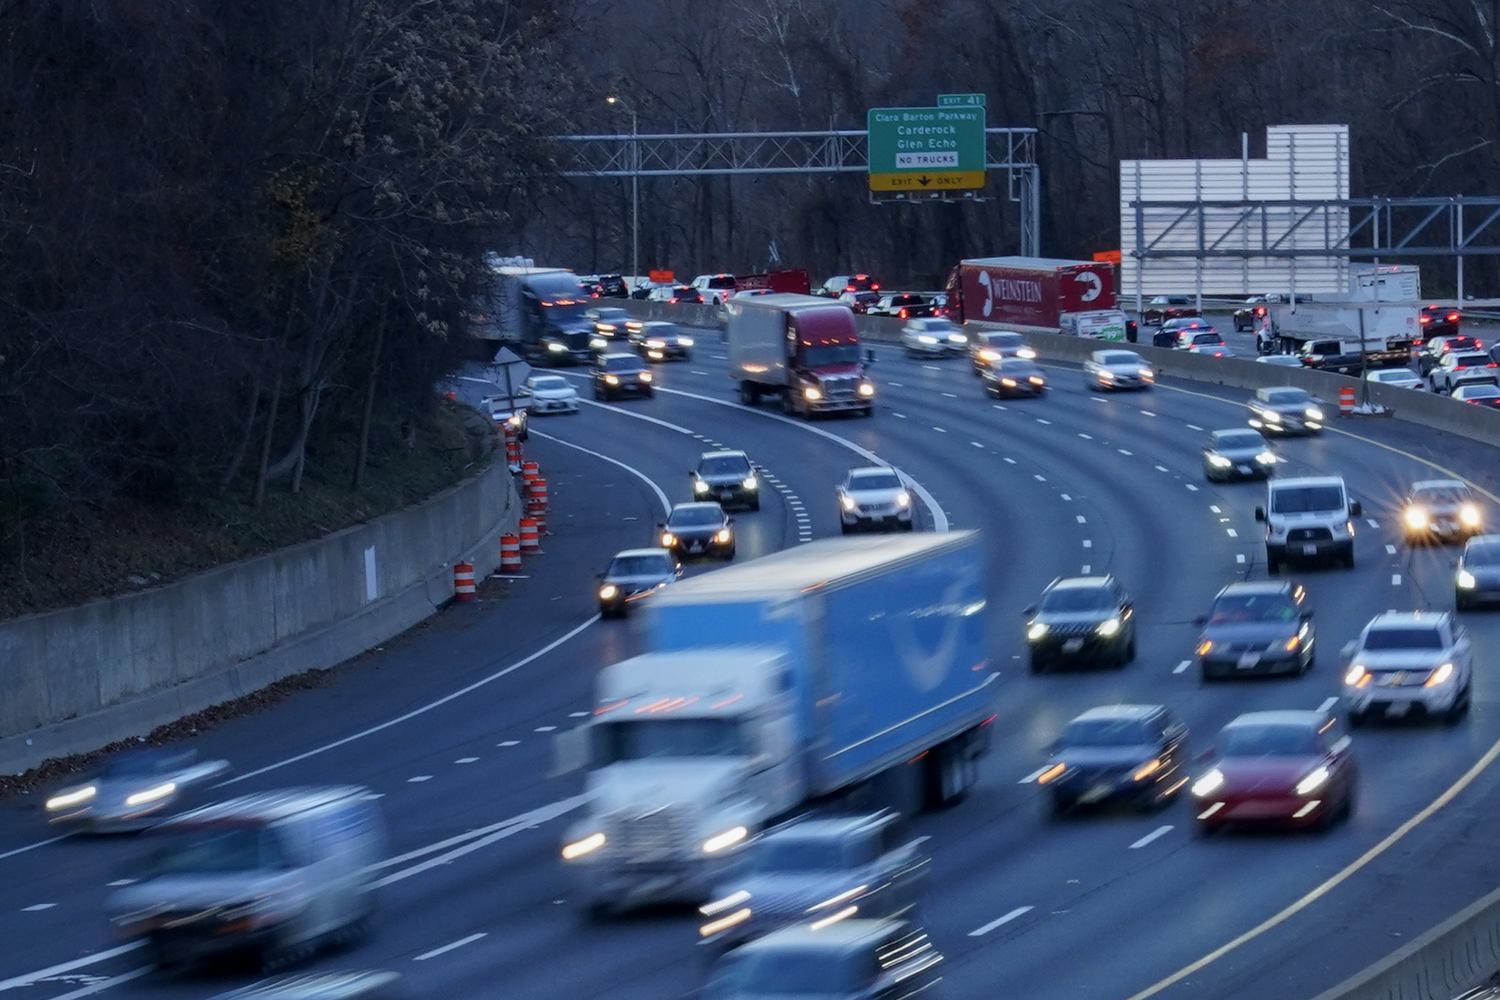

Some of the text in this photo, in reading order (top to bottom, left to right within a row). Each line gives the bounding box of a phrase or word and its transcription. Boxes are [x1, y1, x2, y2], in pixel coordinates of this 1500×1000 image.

[943, 96, 980, 105] EXIT 41
[875, 112, 978, 122] Clara Barton Parkway
[897, 125, 956, 136] Carderock
[897, 138, 957, 149] Glen Echo
[899, 155, 955, 164] NO TRUCKS
[891, 177, 963, 186] EXIT ONLY
[991, 278, 1042, 302] WEINSTEIN
